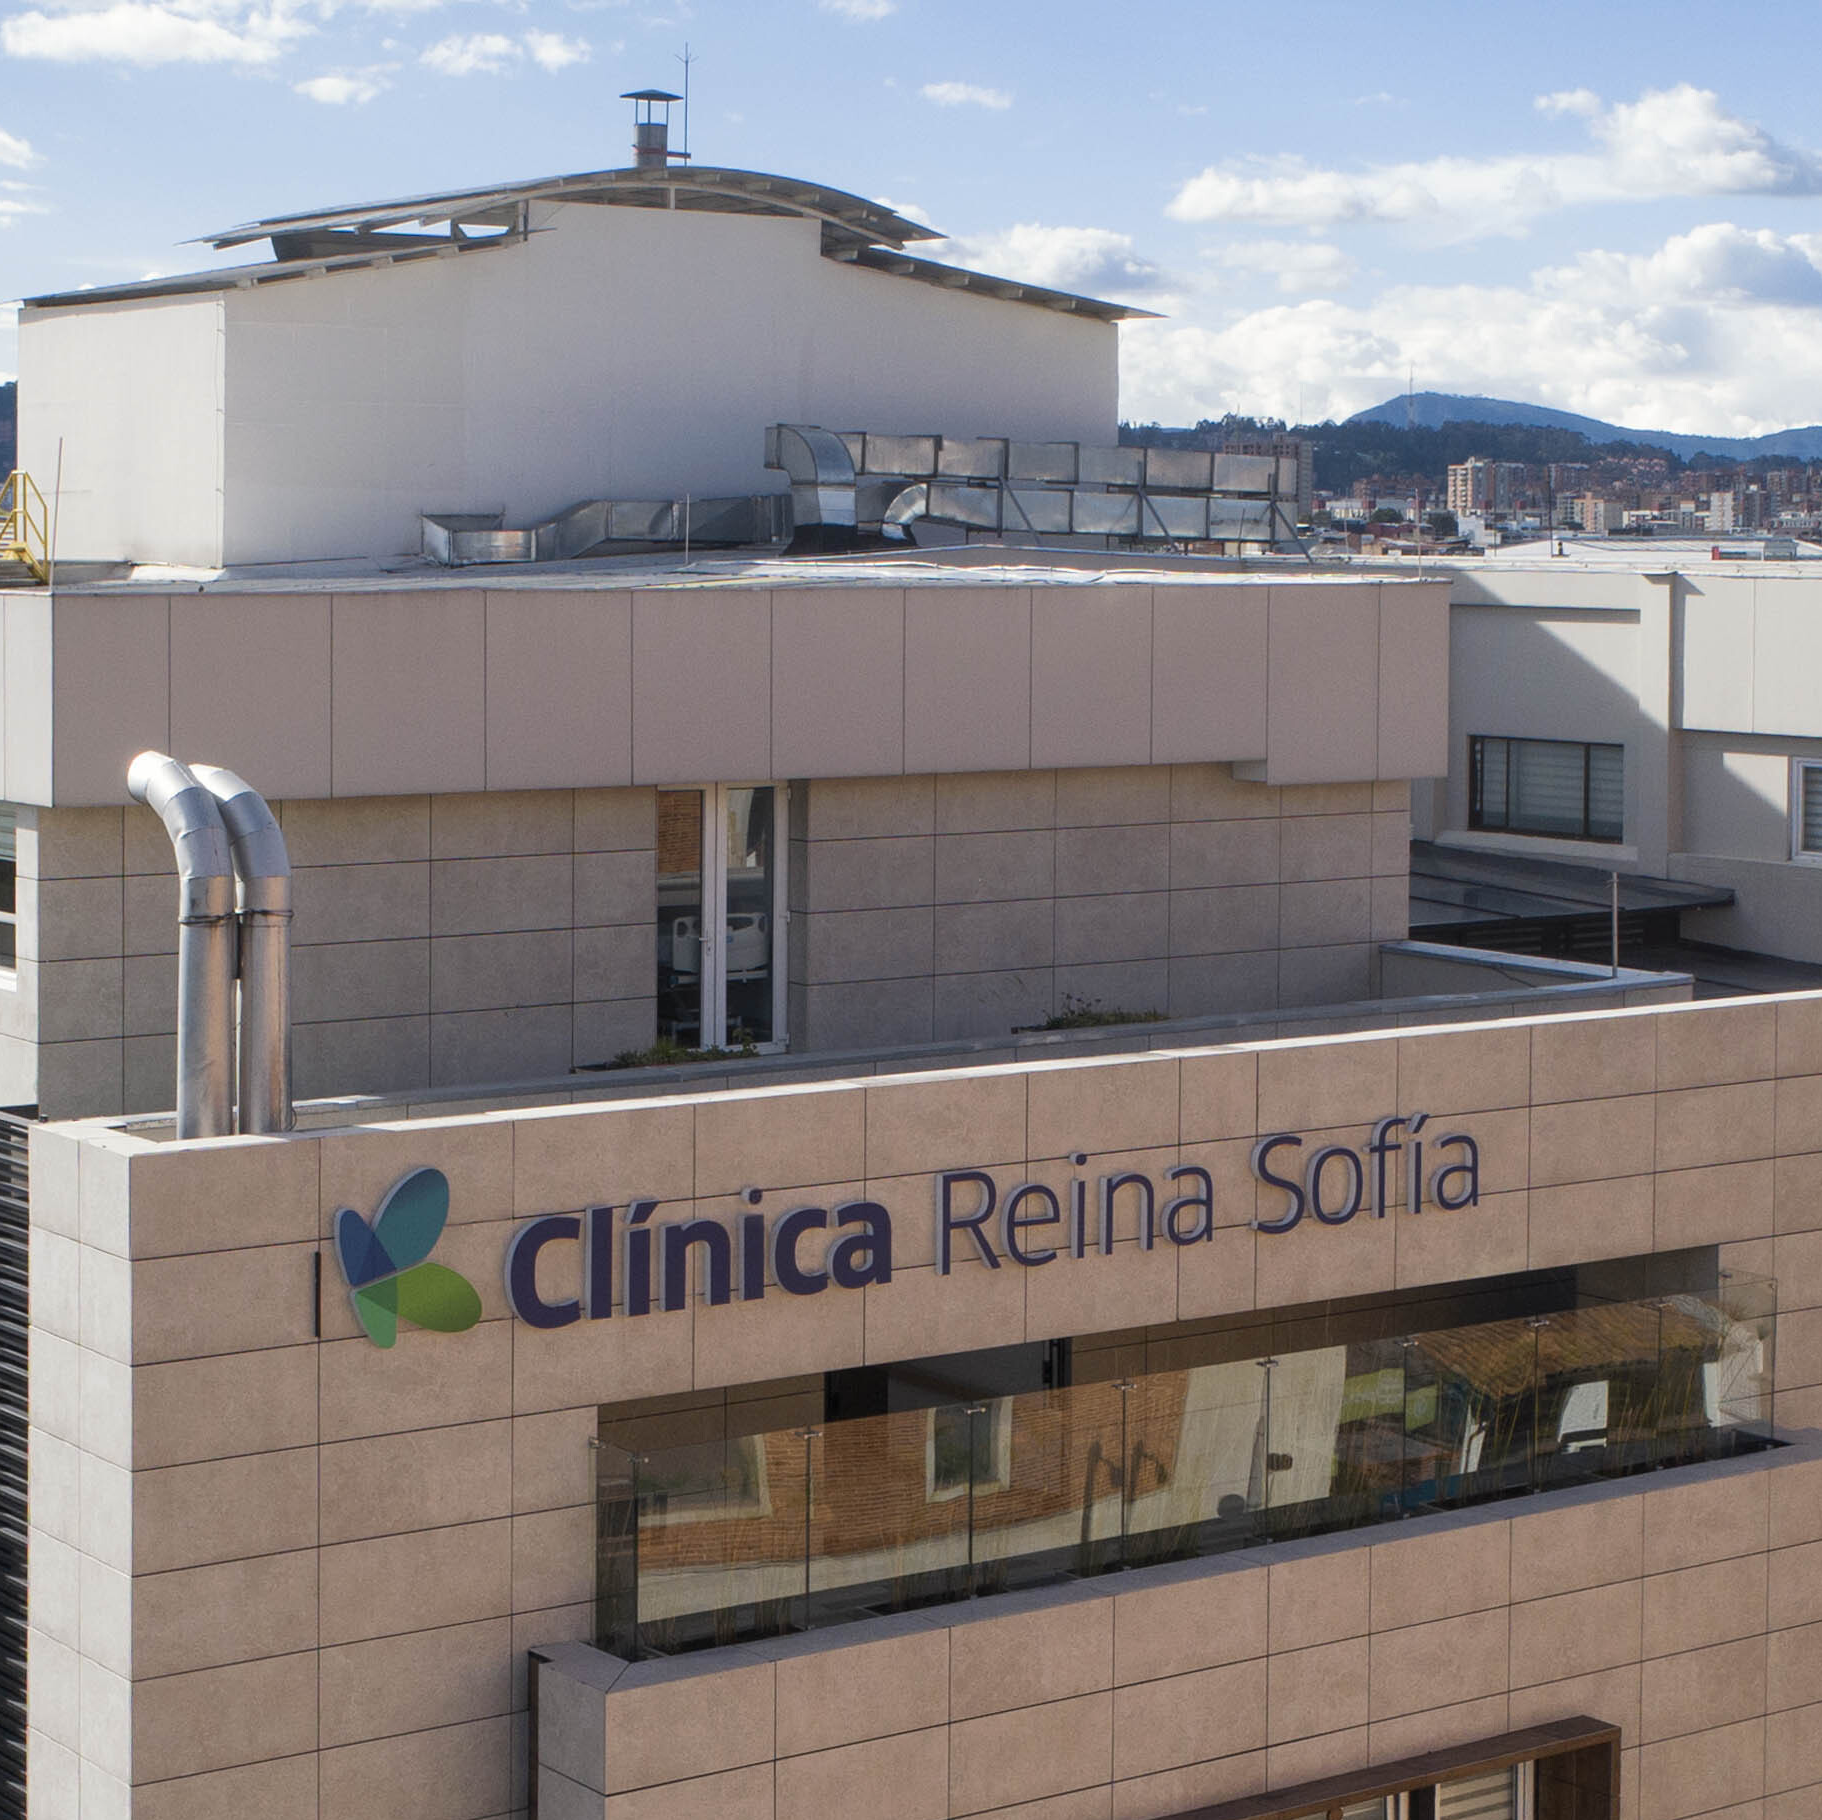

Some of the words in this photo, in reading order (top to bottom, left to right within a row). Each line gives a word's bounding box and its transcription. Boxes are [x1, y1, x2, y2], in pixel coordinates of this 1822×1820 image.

[505, 1186, 893, 1330] Clínica
[935, 1150, 1213, 1276] Reina
[1250, 1112, 1481, 1235] Sofía
